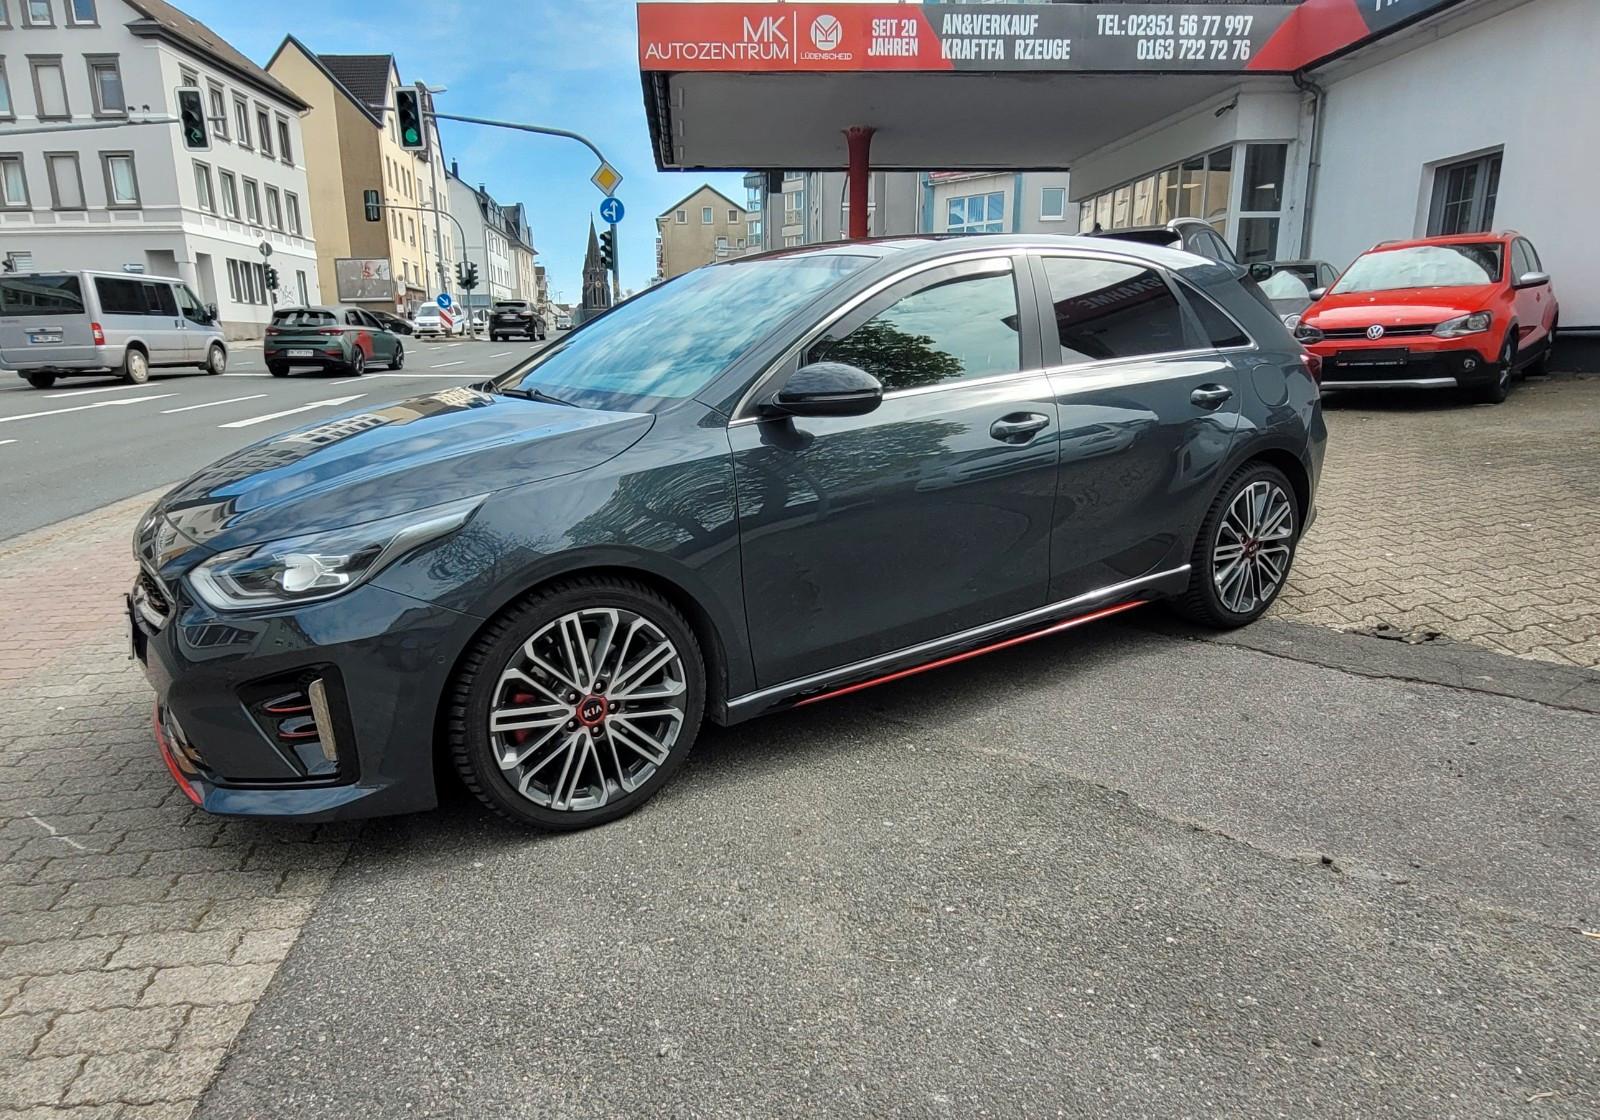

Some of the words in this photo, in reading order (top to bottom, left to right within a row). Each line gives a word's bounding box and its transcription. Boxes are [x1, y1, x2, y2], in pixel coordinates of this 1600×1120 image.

[743, 16, 788, 42] MK
[871, 18, 898, 37] SEIT
[901, 19, 917, 37] 20
[942, 13, 1039, 36] AN&VERKAUF
[1178, 14, 1198, 36] 56
[1202, 15, 1221, 36] 77
[1224, 15, 1253, 36] 997
[645, 42, 789, 60] AUTOZENTRUM
[800, 51, 853, 61] LÜDENSCHEID
[867, 37, 919, 57] JAHREN
[941, 38, 1005, 60] KRAFTFA
[1014, 39, 1071, 60] RZEUGE
[1136, 38, 1174, 60] 0163
[1178, 39, 1206, 60] 722
[1209, 39, 1228, 60] 72
[1231, 39, 1251, 60] 76
[583, 705, 602, 718] KIA
